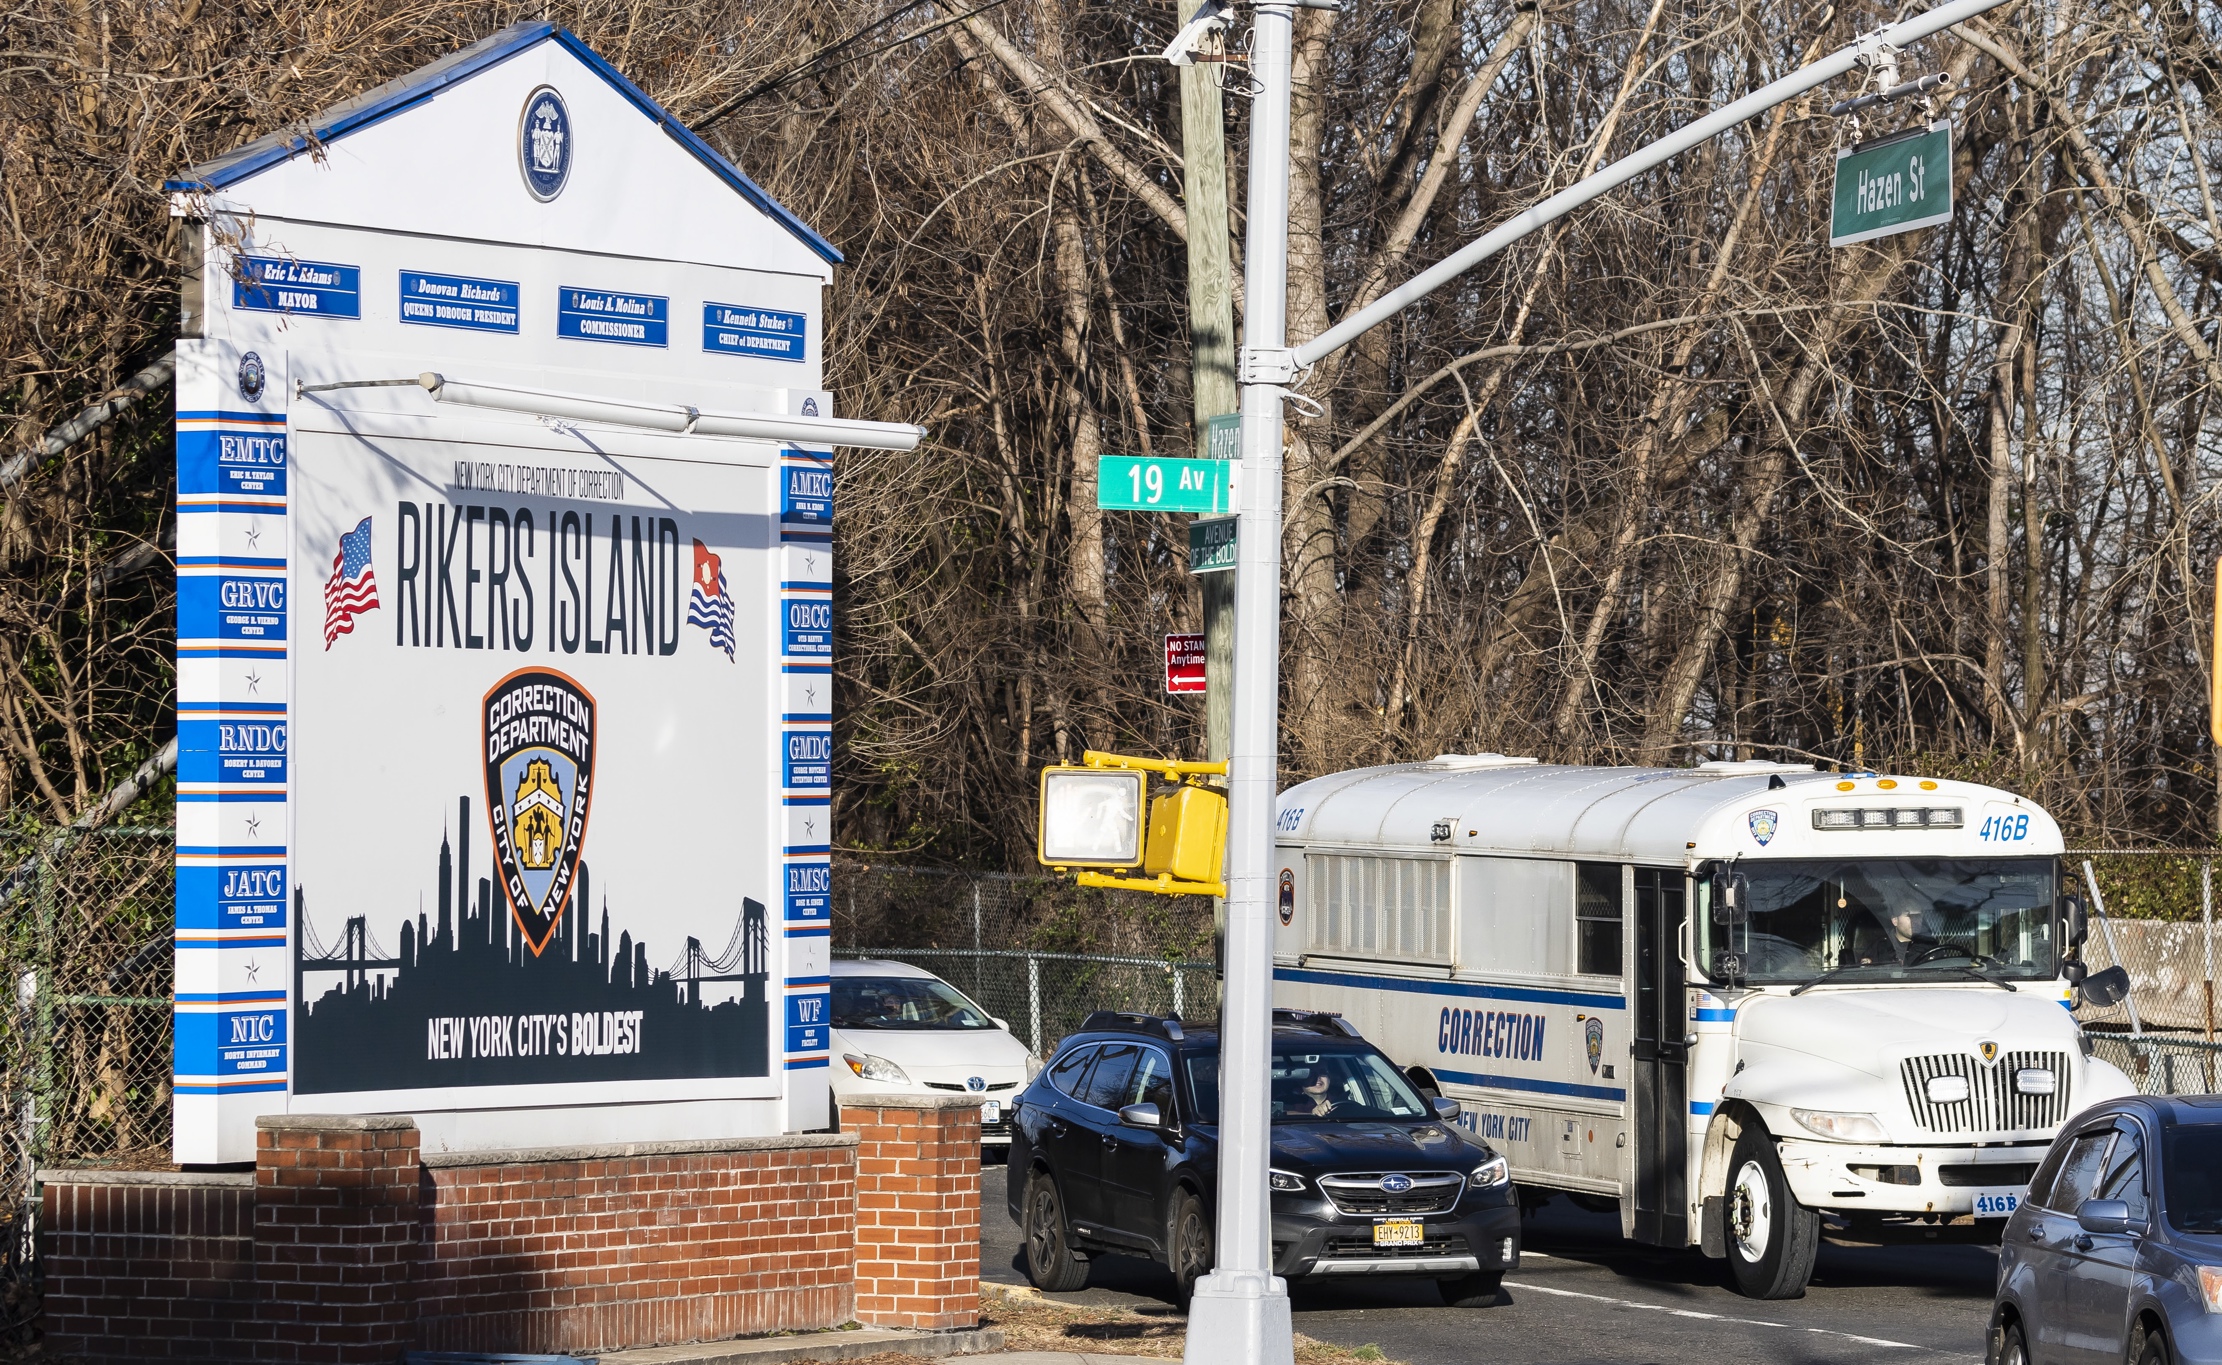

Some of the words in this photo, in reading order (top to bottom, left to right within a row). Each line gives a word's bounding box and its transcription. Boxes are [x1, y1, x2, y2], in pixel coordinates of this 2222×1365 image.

[1857, 169, 1902, 215] Hazen
[1909, 155, 1925, 203] St
[264, 264, 286, 281] Eric
[287, 266, 297, 281] L.
[298, 267, 332, 285] Adams
[278, 291, 317, 309] MAYOR
[418, 279, 458, 297] Donovan
[461, 284, 500, 301] Richards
[403, 302, 434, 317] QUEENS
[436, 305, 472, 321] BOROUGH
[474, 309, 516, 325] PRESIDENT
[580, 294, 604, 311] Louis
[605, 297, 614, 312] A.
[615, 298, 645, 315] Molina
[580, 319, 645, 339] COMMISSIONER
[723, 309, 757, 327] Kenneth
[759, 313, 787, 330] Stukes
[718, 333, 739, 346] CHIEF
[739, 336, 746, 346] of
[746, 336, 791, 351] DEPARTMENT
[219, 436, 284, 464] EMTC
[1212, 424, 1240, 459] Hazen
[454, 461, 474, 491] NEW
[475, 462, 497, 492] YORK
[497, 464, 515, 494] CITY
[516, 465, 566, 497] DEPARTMENT
[568, 469, 577, 498] OF
[579, 470, 624, 500] CORRECTION
[790, 471, 831, 497] AMKC
[1128, 464, 1163, 504] 19
[1205, 523, 1234, 546] AVENUE
[1190, 548, 1199, 567] OF
[1200, 546, 1214, 566] THE
[1216, 543, 1238, 565] BOLD
[397, 501, 534, 652] RIKERS
[549, 510, 679, 656] ISLAND
[221, 580, 283, 609] GRVC
[790, 604, 830, 628] OBCC
[1170, 641, 1182, 651] NO
[1170, 654, 1205, 667] Anytime
[490, 684, 589, 733] CORRECTION
[219, 725, 286, 751] RNDC
[489, 716, 589, 763] DEPARTMENT
[790, 736, 831, 760] GMDC
[1277, 808, 1304, 831] 416B
[1979, 815, 2029, 842] 416B
[492, 804, 513, 865] CITY
[510, 874, 529, 908] OF
[543, 861, 570, 921] NEW
[566, 774, 589, 852] YORK
[224, 870, 281, 897] JATC
[790, 868, 830, 892] RMSC
[798, 998, 822, 1022] WF
[230, 1015, 274, 1042] NIC
[428, 1017, 465, 1060] NEW
[469, 1016, 513, 1058] YORK
[518, 1014, 567, 1056] CITY'S
[571, 1010, 644, 1056] BOLDEST
[1438, 1006, 1546, 1061] CORRECTION
[1456, 1111, 1478, 1134] NEW
[1481, 1113, 1505, 1139] YORK
[1508, 1116, 1531, 1143] CITY
[1977, 1196, 2017, 1212] 416B
[1378, 1226, 1393, 1240] EHY
[1399, 1225, 1420, 1239] 9213
